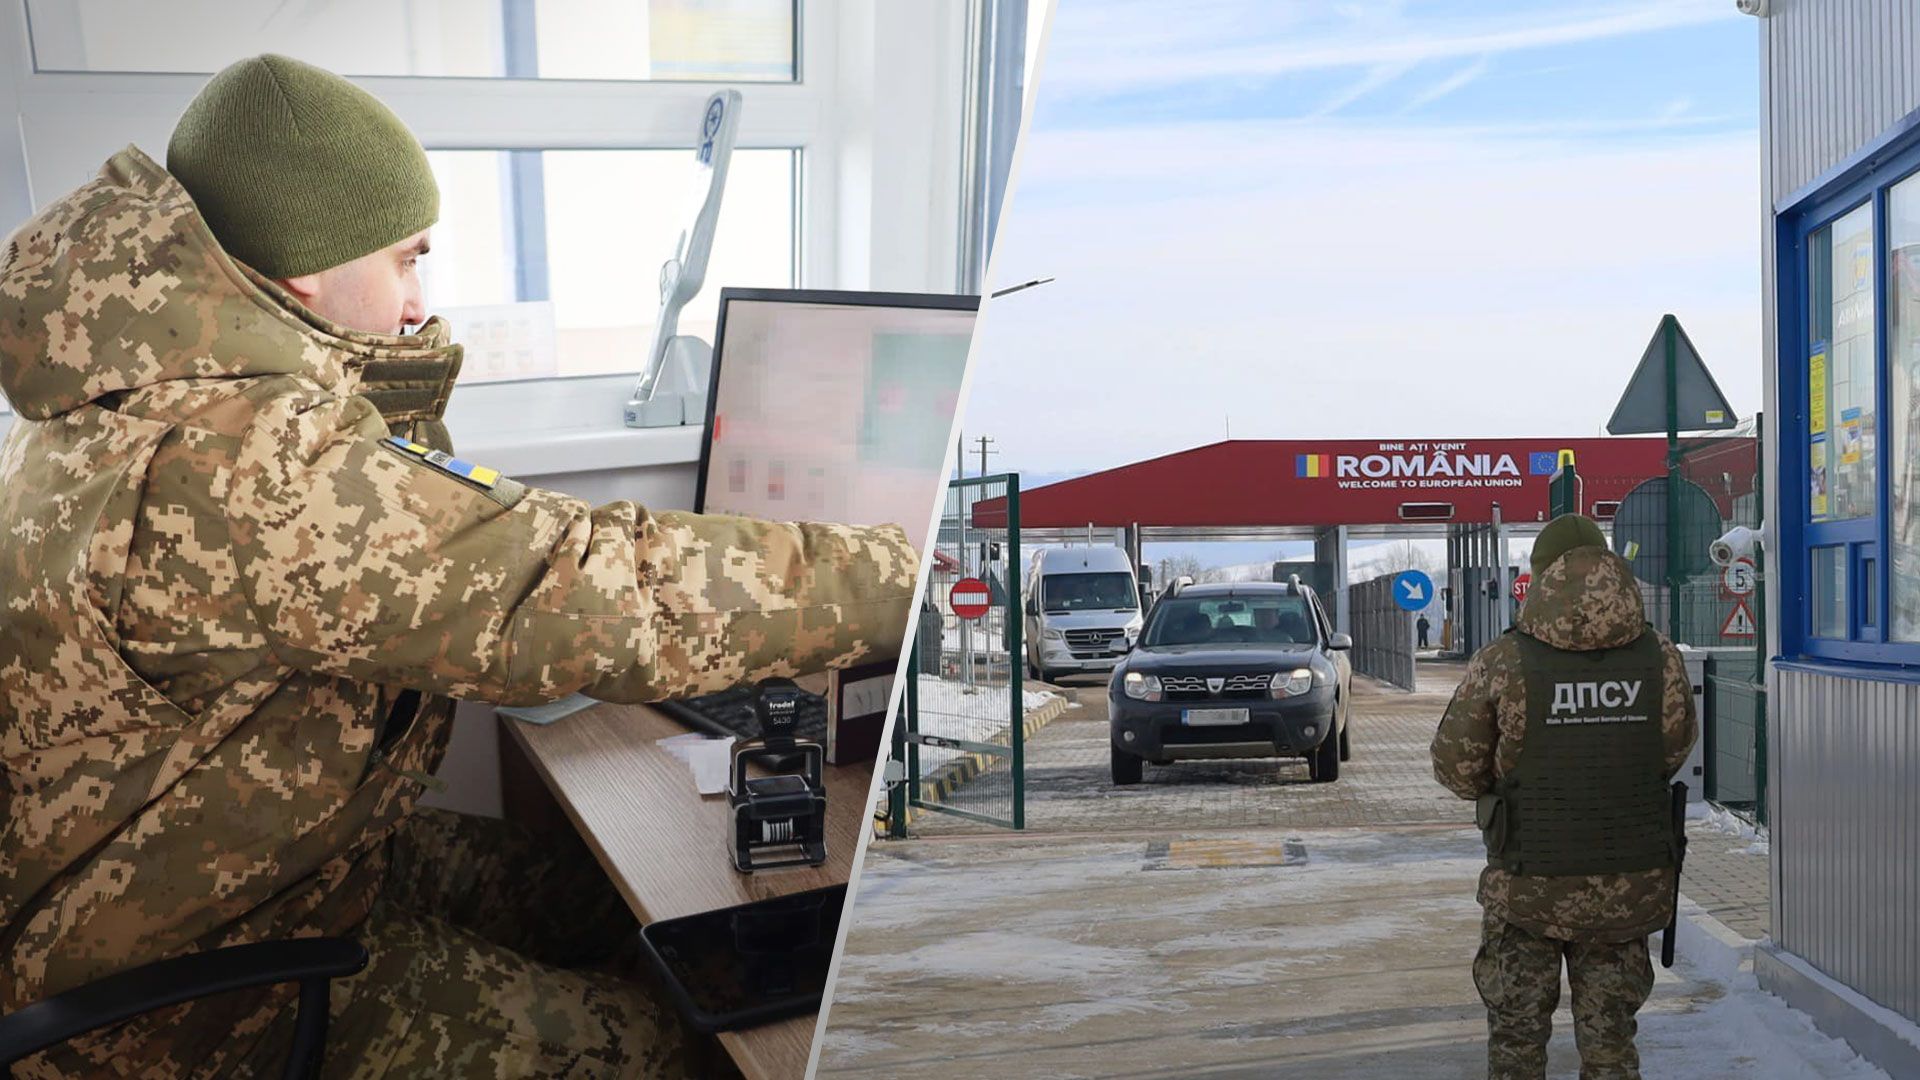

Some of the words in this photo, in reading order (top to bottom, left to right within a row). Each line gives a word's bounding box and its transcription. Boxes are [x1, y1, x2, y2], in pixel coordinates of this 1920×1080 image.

[1379, 443, 1405, 451] BINE
[1432, 443, 1466, 451] VENIT
[1336, 450, 1520, 478] ROMÂNIA
[1338, 480, 1397, 489] WELCOME
[1401, 480, 1417, 488] TO
[1419, 479, 1482, 488] EUROPEAN
[1484, 479, 1522, 487] UNION
[1735, 568, 1745, 588] 5
[1514, 582, 1531, 594] ST
[1551, 680, 1642, 715] ДПСУ
